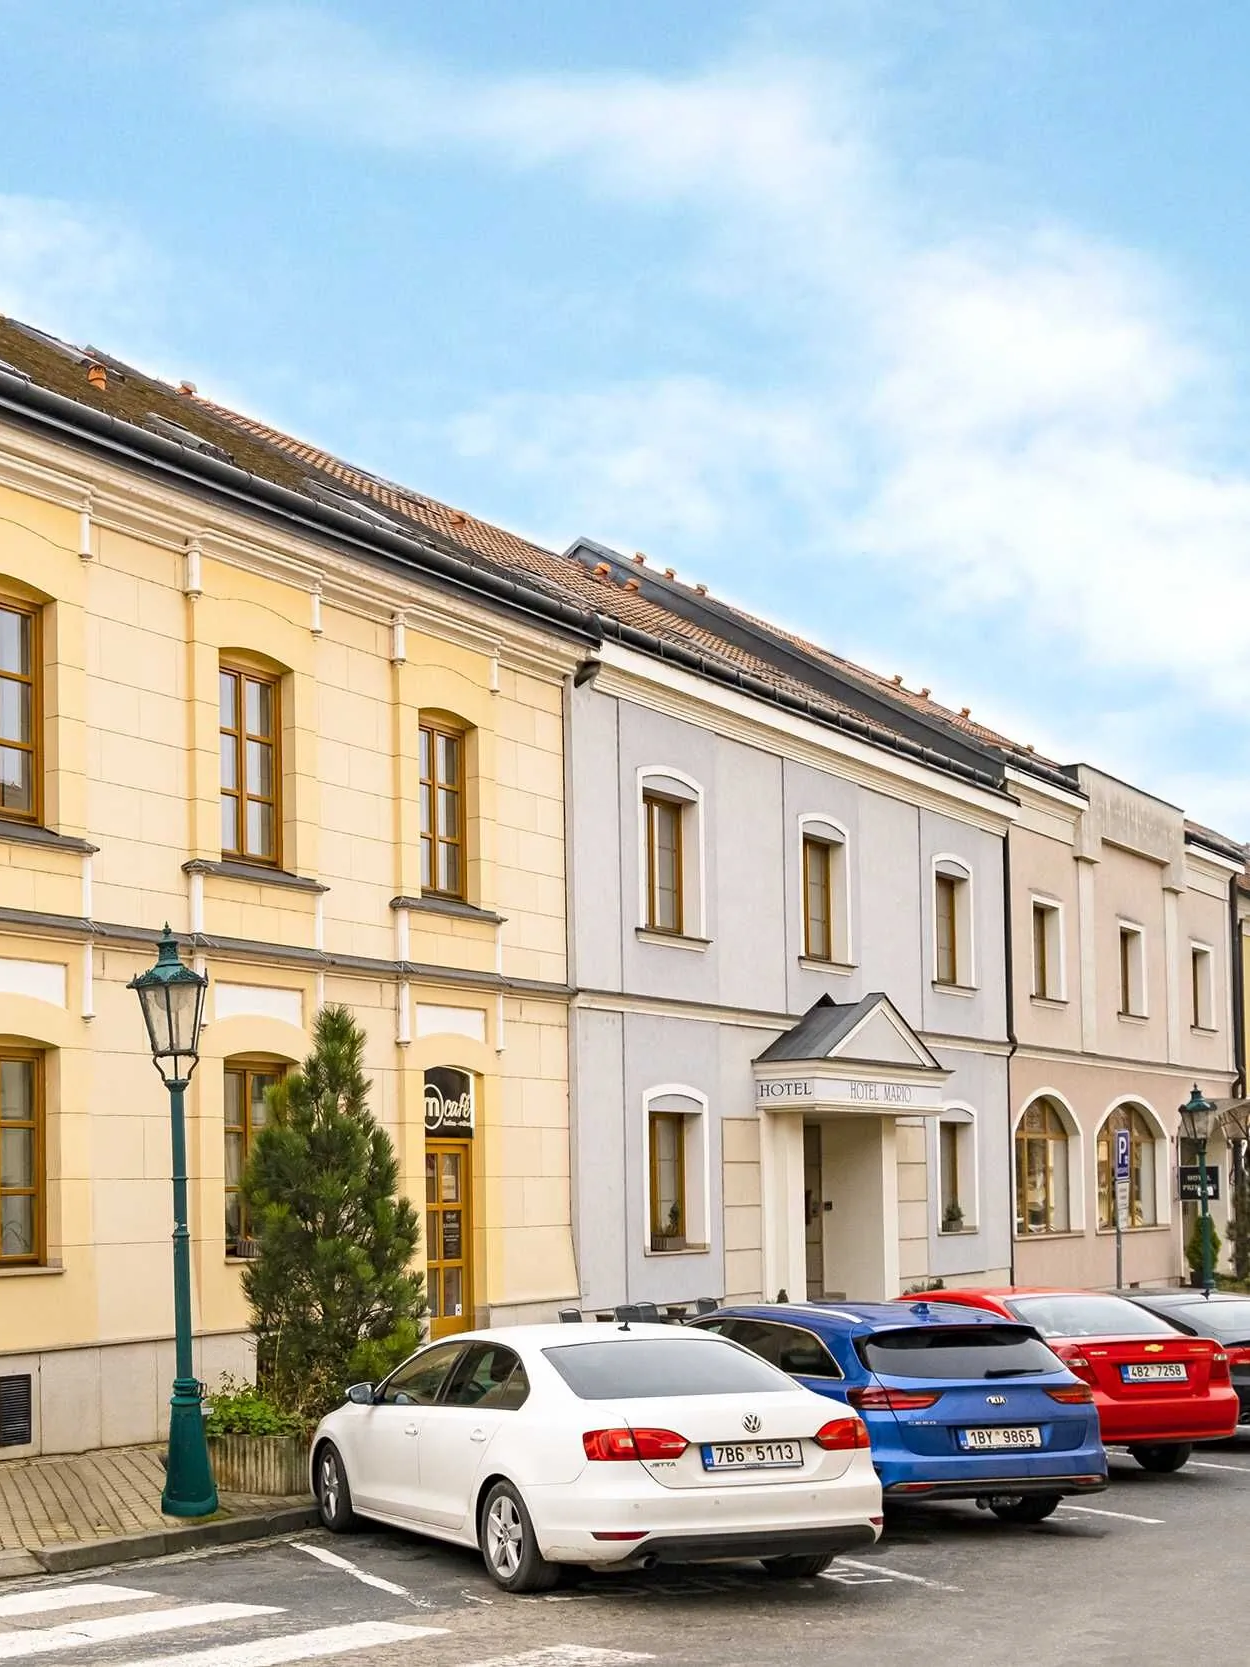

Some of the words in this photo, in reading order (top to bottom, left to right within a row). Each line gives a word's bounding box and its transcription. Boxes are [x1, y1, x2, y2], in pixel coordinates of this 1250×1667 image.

[760, 1082, 812, 1097] HOTEL
[850, 1081, 878, 1101] HOTEL
[884, 1085, 911, 1103] MARIO
[444, 1093, 471, 1118] café
[1119, 1136, 1127, 1165] P
[1158, 1365, 1182, 1377] 7258
[971, 1430, 992, 1445] 1BY
[1003, 1429, 1035, 1443] 9865
[716, 1446, 745, 1464] 7B6
[755, 1444, 794, 1461] 5113
